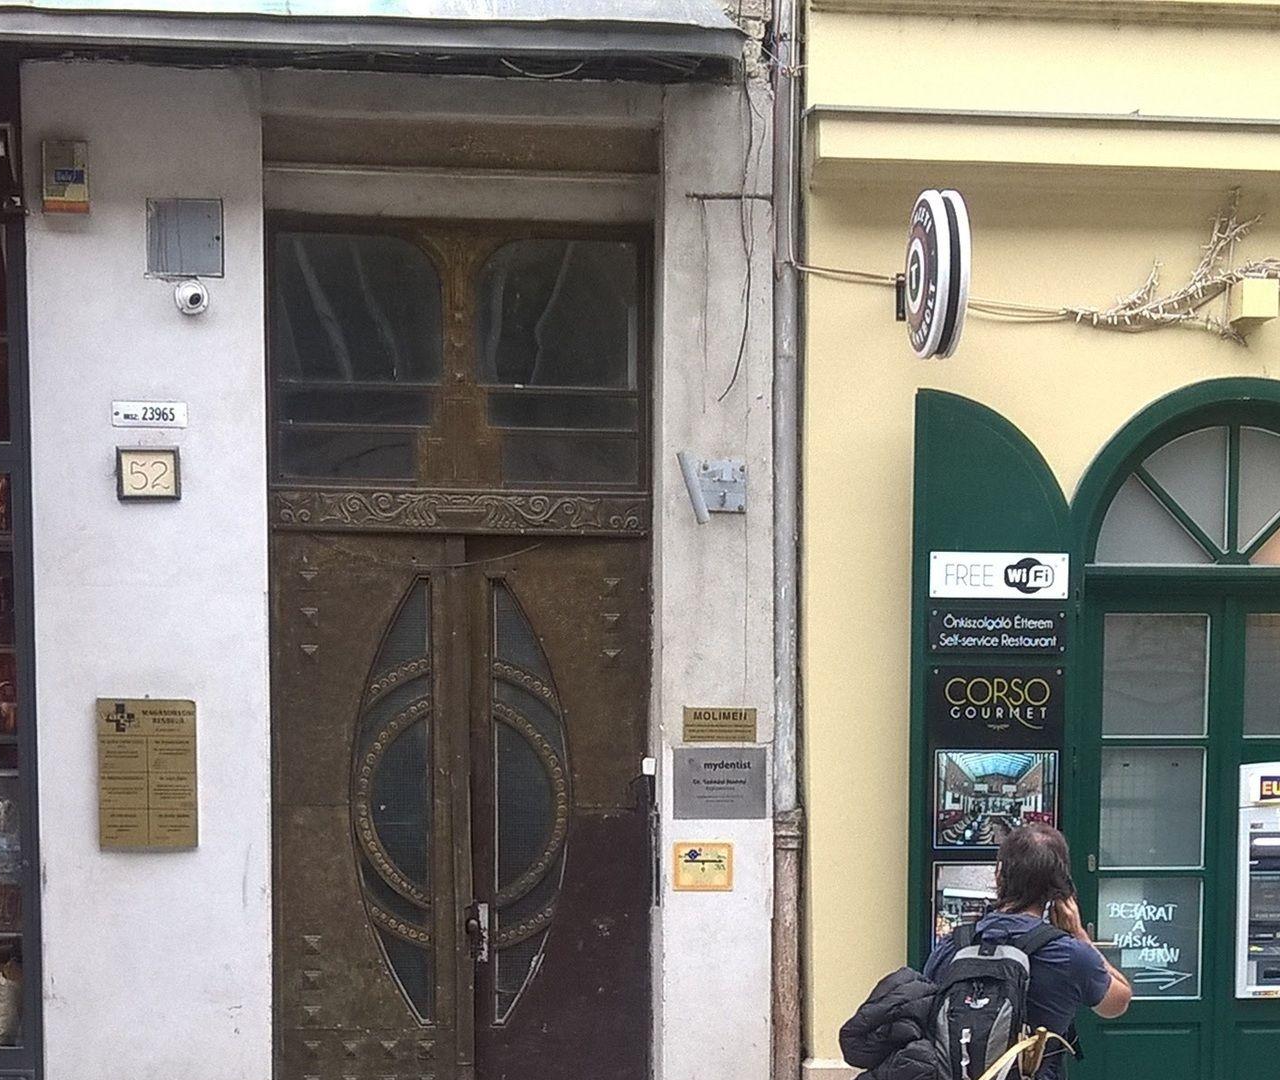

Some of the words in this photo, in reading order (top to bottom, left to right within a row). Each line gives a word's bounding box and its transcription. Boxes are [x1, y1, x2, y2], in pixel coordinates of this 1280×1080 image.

[141, 407, 176, 421] 23965
[130, 460, 170, 490] 52
[944, 563, 994, 587] FREE
[1014, 613, 1054, 629] Étterem
[939, 632, 1000, 647] Self-service
[1001, 632, 1058, 647] Restaurant
[945, 677, 1051, 707] CORSO
[692, 710, 748, 721] MOLIMEN
[950, 706, 1048, 719] GOURMET
[703, 759, 752, 772] mydentist
[1106, 900, 1178, 921] BEJÁRAT
[1132, 920, 1146, 932] A
